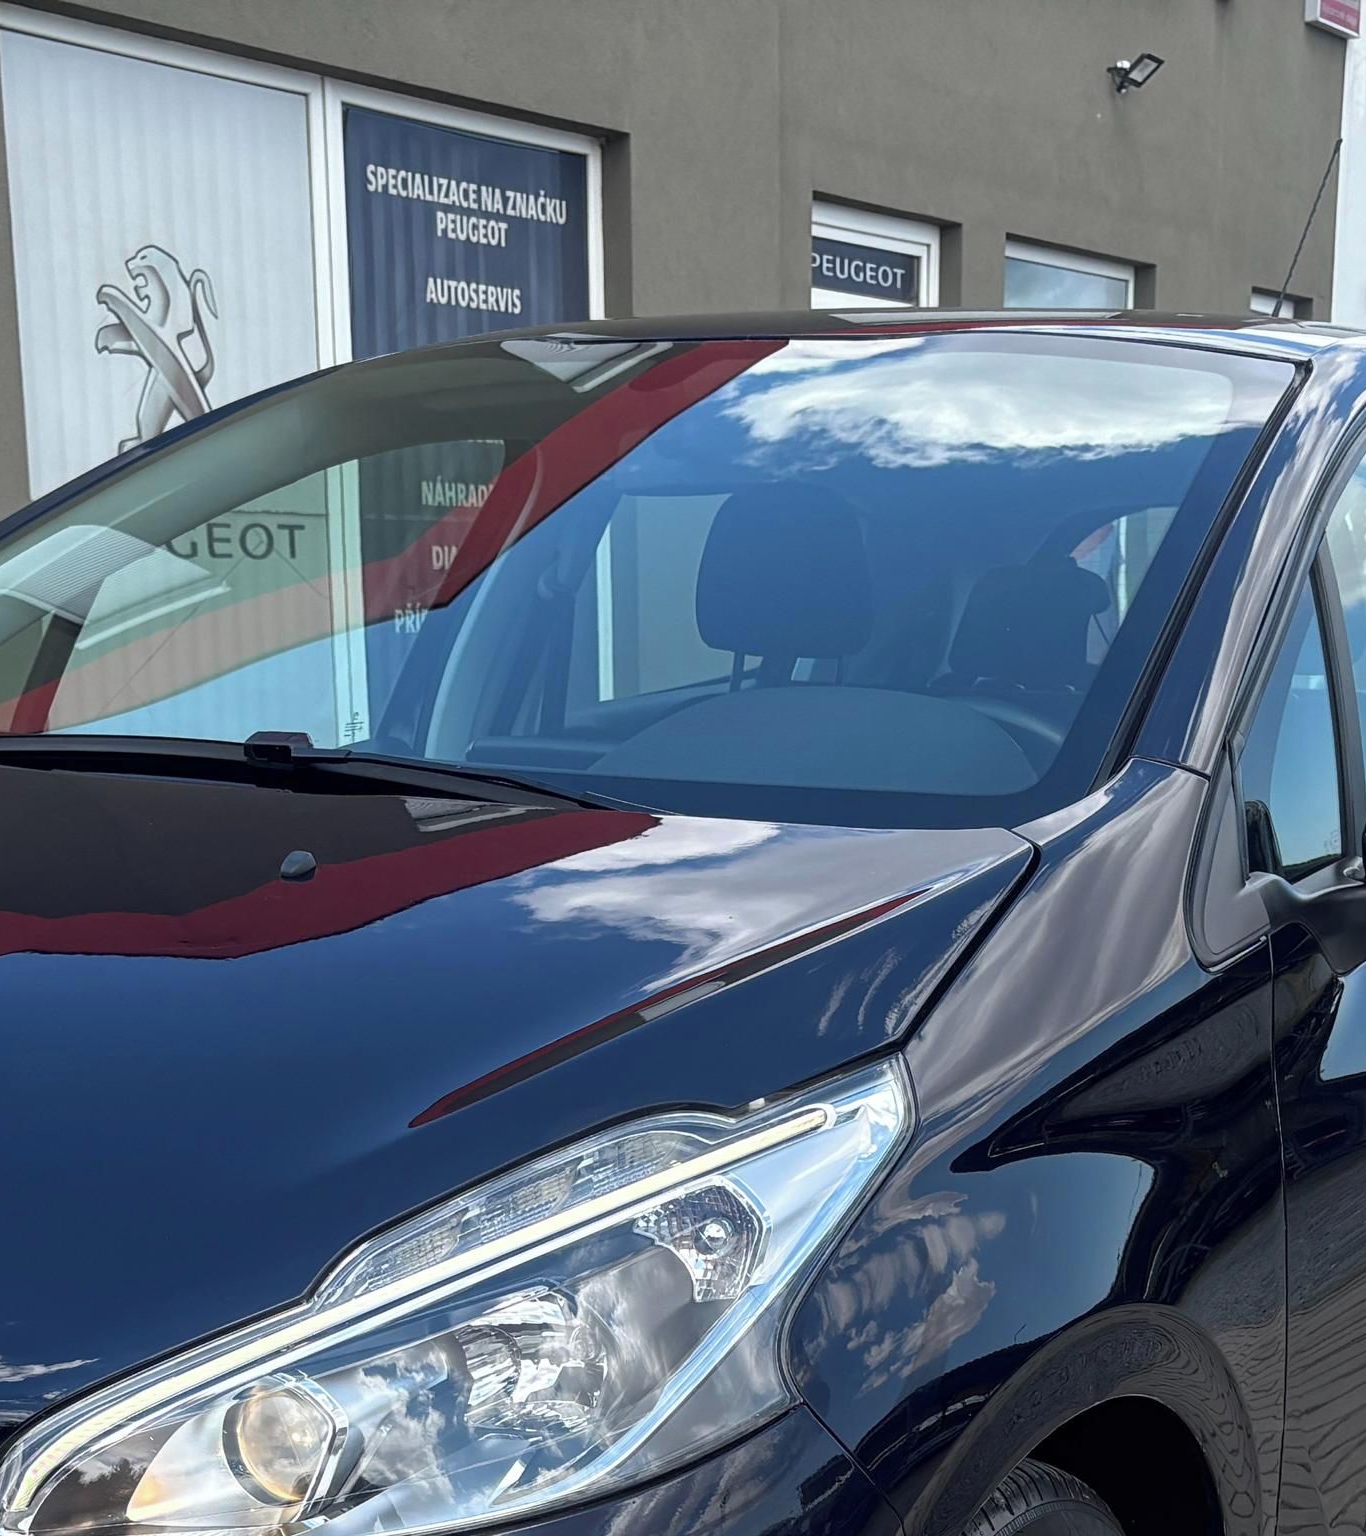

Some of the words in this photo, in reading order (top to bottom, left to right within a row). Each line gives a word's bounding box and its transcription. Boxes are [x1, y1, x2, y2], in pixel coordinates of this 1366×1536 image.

[366, 164, 479, 210] SPECIALIZACE
[480, 185, 504, 215] NA
[505, 189, 567, 225] ZNAČKU
[436, 211, 508, 247] PEUGEOT
[426, 276, 521, 315] AUTOSERVIS
[421, 475, 495, 508] NÁHRAD
